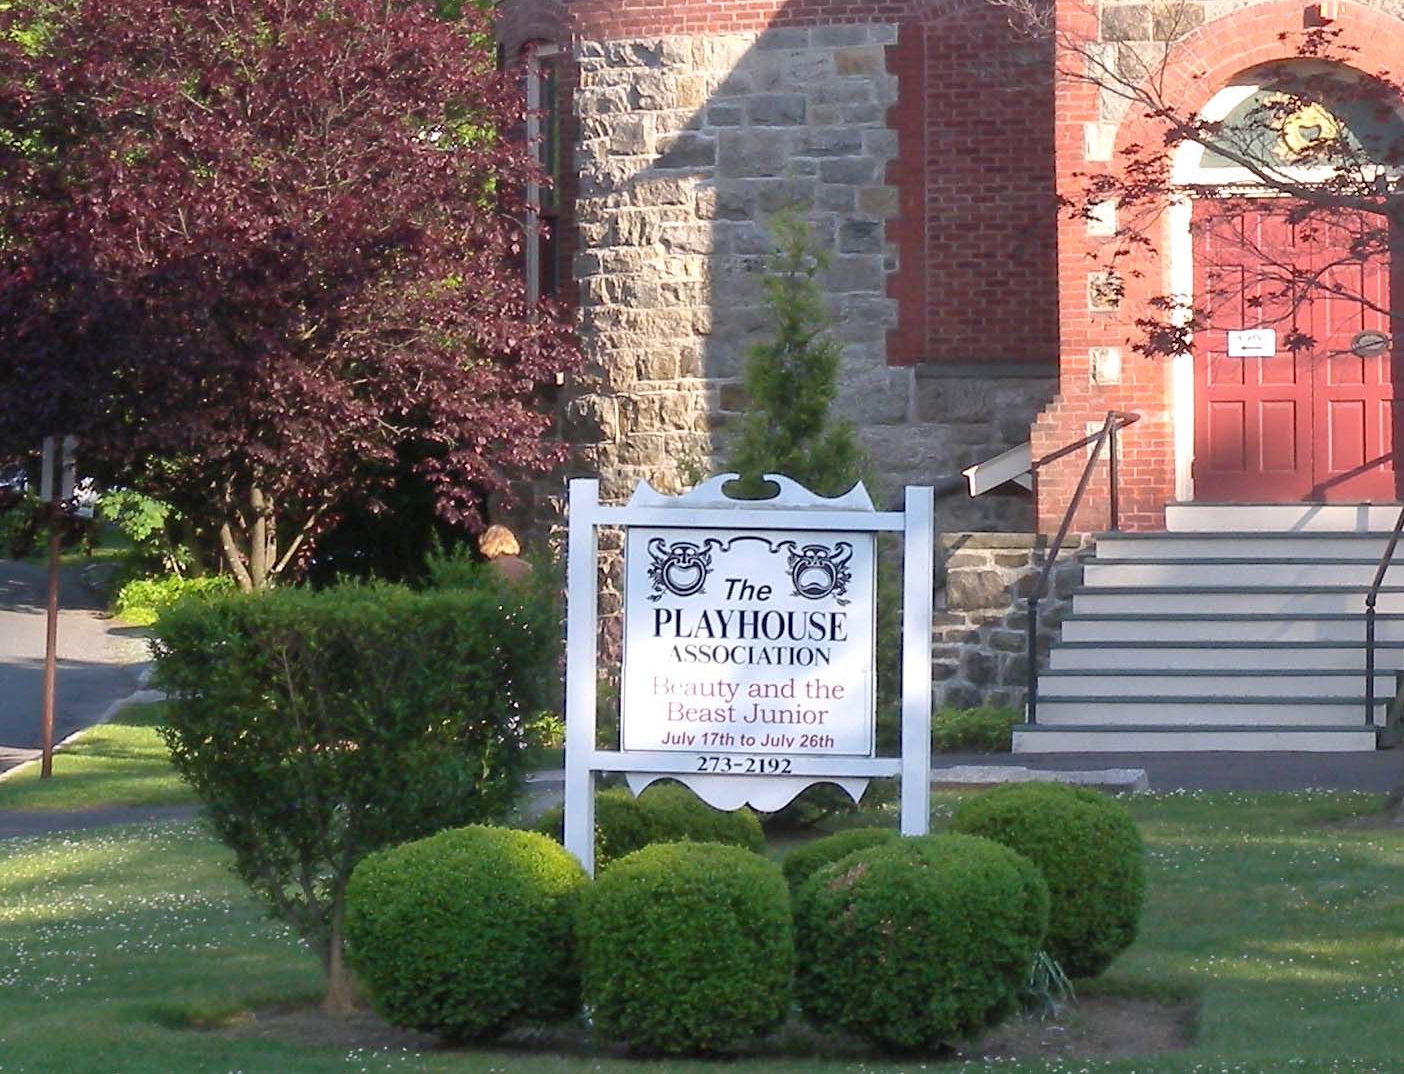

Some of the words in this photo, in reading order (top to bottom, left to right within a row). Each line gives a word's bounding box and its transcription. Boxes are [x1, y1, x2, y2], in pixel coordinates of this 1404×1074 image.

[725, 578, 773, 601] The
[653, 608, 848, 642] PLAYHOUSE
[668, 643, 832, 666] ASSOCIATION
[653, 676, 740, 703] Beauty
[747, 678, 795, 699] and
[805, 678, 845, 700] the
[668, 701, 737, 723] Beast
[743, 703, 829, 725] Junior
[661, 731, 696, 746] July
[702, 732, 735, 746] 17th
[740, 733, 756, 747] to
[760, 734, 795, 748] July
[800, 734, 835, 748] 26th
[696, 756, 792, 774] 273-2192
